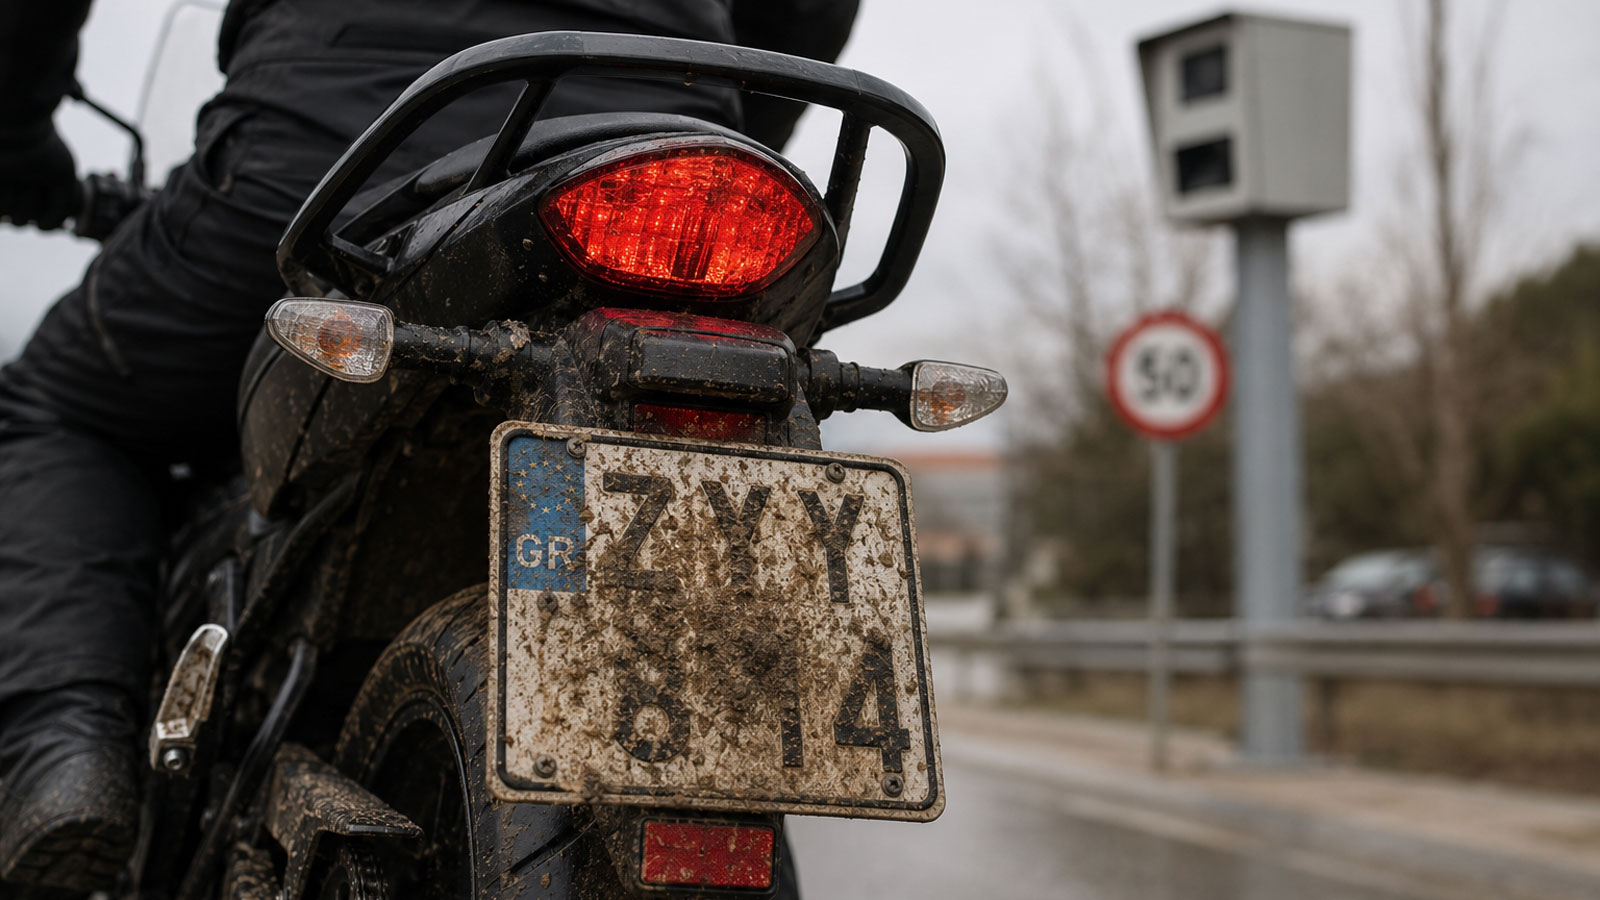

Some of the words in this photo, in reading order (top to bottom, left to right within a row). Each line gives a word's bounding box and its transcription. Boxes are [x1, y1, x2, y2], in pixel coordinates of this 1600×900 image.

[1134, 346, 1201, 403] 50
[516, 533, 575, 571] GR
[602, 472, 865, 604] ZYY
